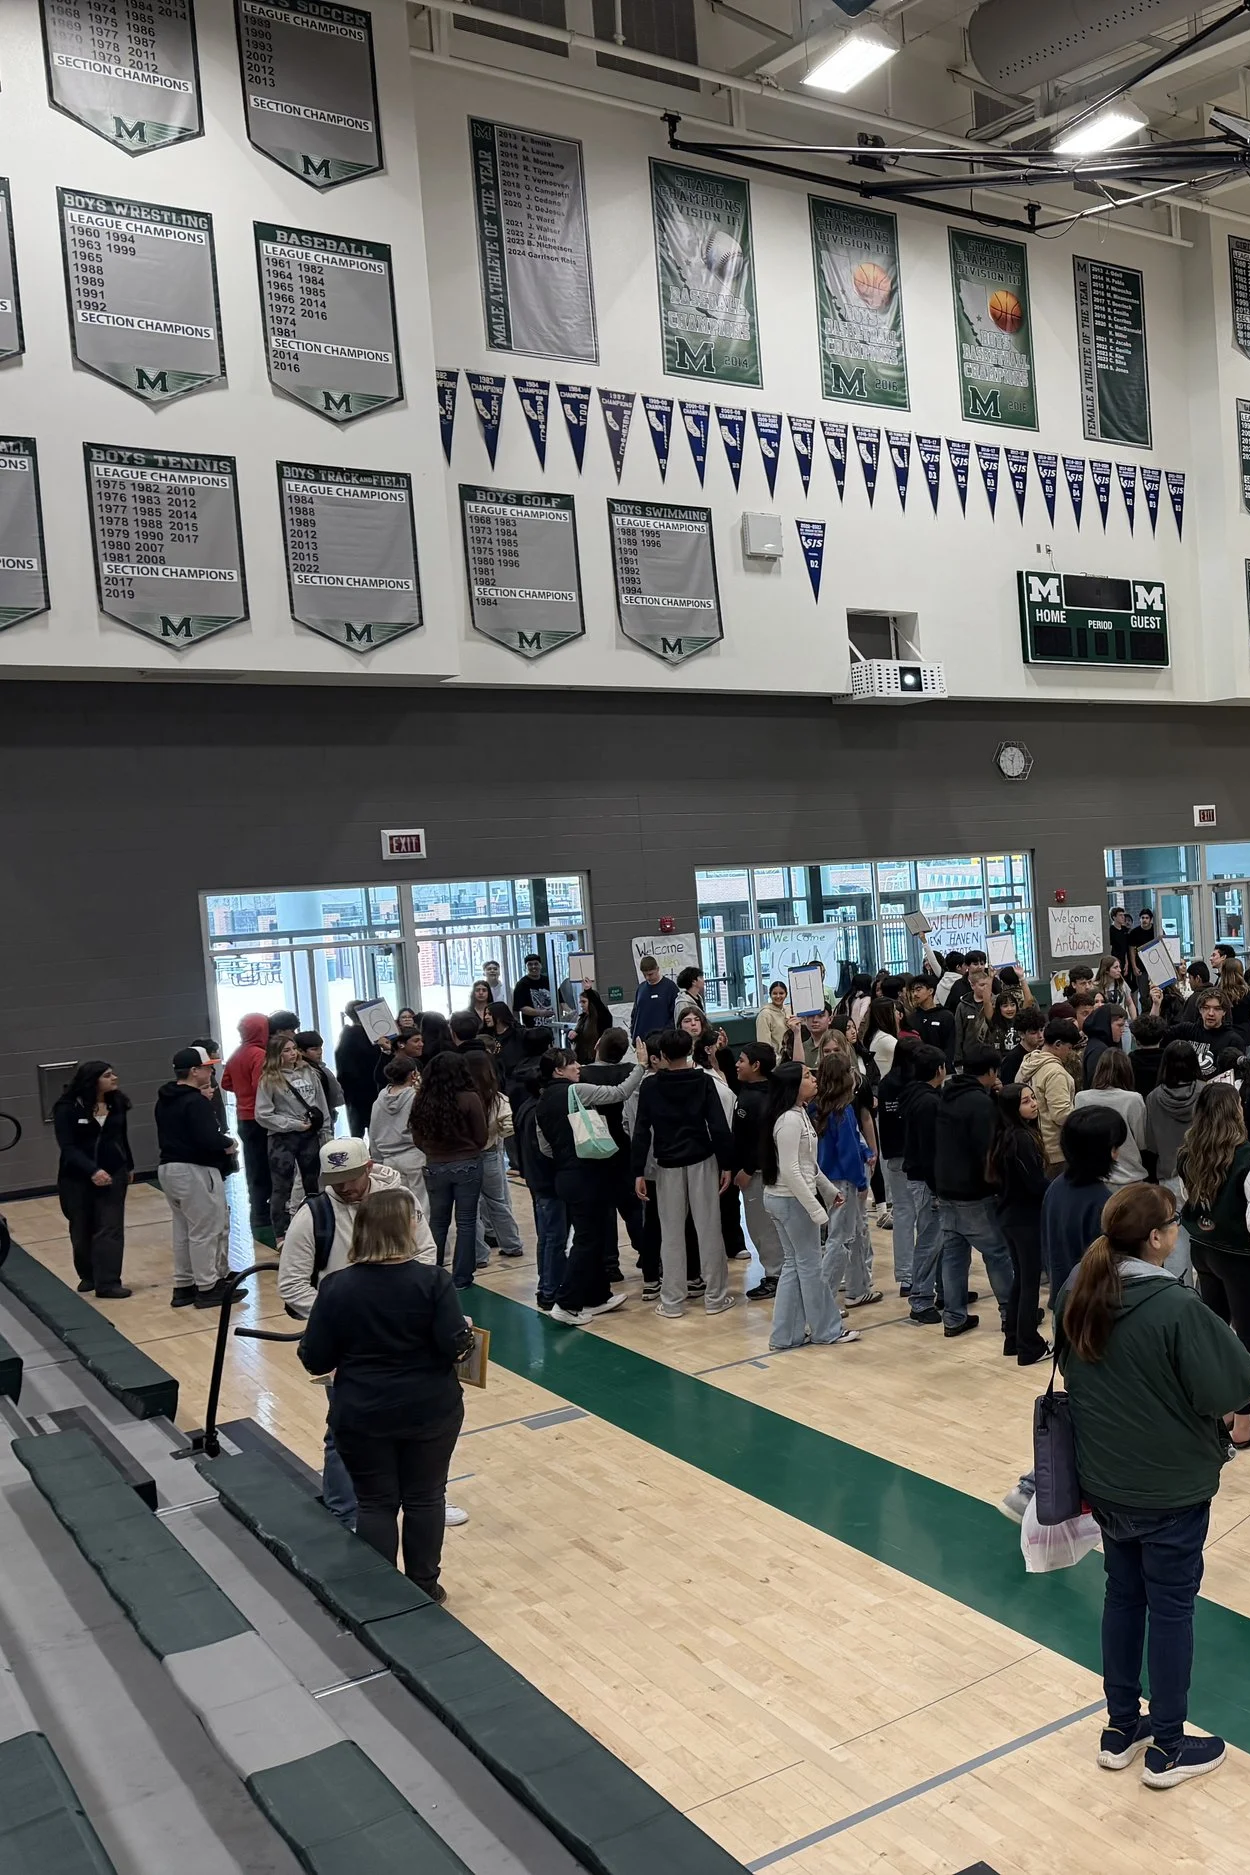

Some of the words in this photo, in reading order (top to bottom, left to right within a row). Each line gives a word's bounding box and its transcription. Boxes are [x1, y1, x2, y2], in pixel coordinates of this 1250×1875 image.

[243, 3, 290, 25] LEAGUE
[293, 15, 363, 40] CHAMPIONS
[297, 0, 366, 28] SOCCER
[246, 51, 273, 64] 2007
[57, 54, 112, 76] SECTION
[114, 67, 189, 93] CHAMPIONS
[248, 74, 276, 87] 2013
[253, 97, 301, 116] SECTION
[303, 109, 370, 131] CHAMPIONS
[113, 116, 146, 143] M
[473, 123, 491, 139] M
[302, 155, 331, 179] M
[479, 150, 494, 184] YEAR
[676, 175, 723, 195] STATE
[481, 188, 496, 214] THE
[657, 185, 741, 213] CHAMPIONS
[64, 193, 107, 212] BOYS
[112, 202, 208, 230] WRESTLING
[70, 213, 122, 231] LEAGUE
[126, 223, 203, 244] CHAMPIONS
[70, 226, 100, 239] 1960
[106, 231, 135, 244] 1994
[485, 220, 498, 237] OF
[817, 218, 889, 242] CHAMPIONS
[276, 231, 373, 257] BASEBALL
[508, 248, 526, 257] 2024
[968, 240, 1007, 258] STATE
[265, 245, 311, 263] LEAGUE
[314, 253, 383, 273] CHAMPIONS
[265, 258, 291, 269] 1961
[298, 264, 324, 275] 1982
[956, 250, 1021, 273] CHAMPIONS
[1078, 262, 1087, 273] M
[485, 241, 503, 303] ATHLETE
[958, 265, 1004, 282] DIVISION
[1079, 280, 1089, 307] YEAR
[81, 312, 134, 328] SECTION
[137, 320, 211, 338] CHAMPIONS
[491, 305, 507, 346] MALE
[668, 311, 750, 340] CHAMPIONS
[1082, 309, 1090, 329] THE
[1082, 333, 1090, 346] OF
[273, 350, 299, 362] 2014
[274, 338, 322, 353] SECTION
[324, 346, 390, 362] CHAMPIONS
[674, 336, 715, 373] M
[724, 355, 748, 369] 2014
[1082, 347, 1093, 392] ATHLETE
[136, 368, 168, 391] M
[471, 383, 503, 393] CHAMPIONS
[479, 376, 494, 384] 1983
[831, 363, 867, 397] M
[875, 380, 898, 391] 2016
[518, 387, 548, 395] CHAMPIONS
[323, 391, 352, 413] M
[970, 386, 1001, 418] M
[1084, 395, 1096, 436] FEMALE
[91, 449, 145, 465] BOYS
[153, 456, 231, 473] TENNIS
[96, 467, 147, 481] LEAGUE
[151, 472, 228, 488] CHAMPIONS
[283, 466, 314, 482] BOYS
[320, 470, 359, 485] TRACK
[373, 474, 407, 488] FIELD
[96, 480, 126, 492] 1975
[131, 483, 160, 494] 1982
[166, 486, 195, 496] 2010
[288, 484, 332, 496] LEAGUE
[335, 487, 404, 501] CHAMPIONS
[288, 495, 314, 505] 1984
[476, 491, 517, 504] BOYS
[522, 494, 560, 507] GOLF
[468, 505, 508, 516] LEAGUE
[510, 509, 568, 521] CHAMPIONS
[469, 515, 491, 525] 1968
[495, 518, 517, 526] 1983
[614, 503, 642, 515] BOYS
[646, 507, 707, 521] SWIMMING
[616, 518, 651, 528] LEAGUE
[653, 521, 705, 532] CHAMPIONS
[107, 564, 159, 577] SECTION
[162, 566, 234, 581] CHAMPIONS
[810, 560, 819, 568] D2
[104, 577, 133, 587] 2017
[297, 575, 343, 586] SECTION
[345, 576, 410, 589] CHAMPIONS
[1028, 576, 1060, 603] M
[476, 597, 497, 606] 1984
[477, 588, 517, 597] SECTION
[519, 590, 573, 600] CHAMPIONS
[624, 596, 660, 605] SECTION
[662, 598, 711, 608] CHAMPIONS
[1135, 585, 1164, 611] M
[161, 617, 193, 637] M
[1036, 609, 1066, 623] HOME
[1131, 615, 1161, 629] GUEST
[1088, 620, 1112, 630] PERIOD
[345, 623, 373, 643] M
[518, 632, 542, 649] M
[661, 638, 683, 654] M
[1200, 810, 1213, 821] EXIT
[393, 836, 417, 852] EXIT
[1051, 909, 1094, 923] Welcome
[950, 932, 979, 945] HAVEN
[635, 941, 684, 957] Welcome
[992, 940, 1008, 962] 7
[1148, 949, 1171, 978] 9
[794, 975, 813, 1008] 4
[367, 1008, 391, 1035] 6
